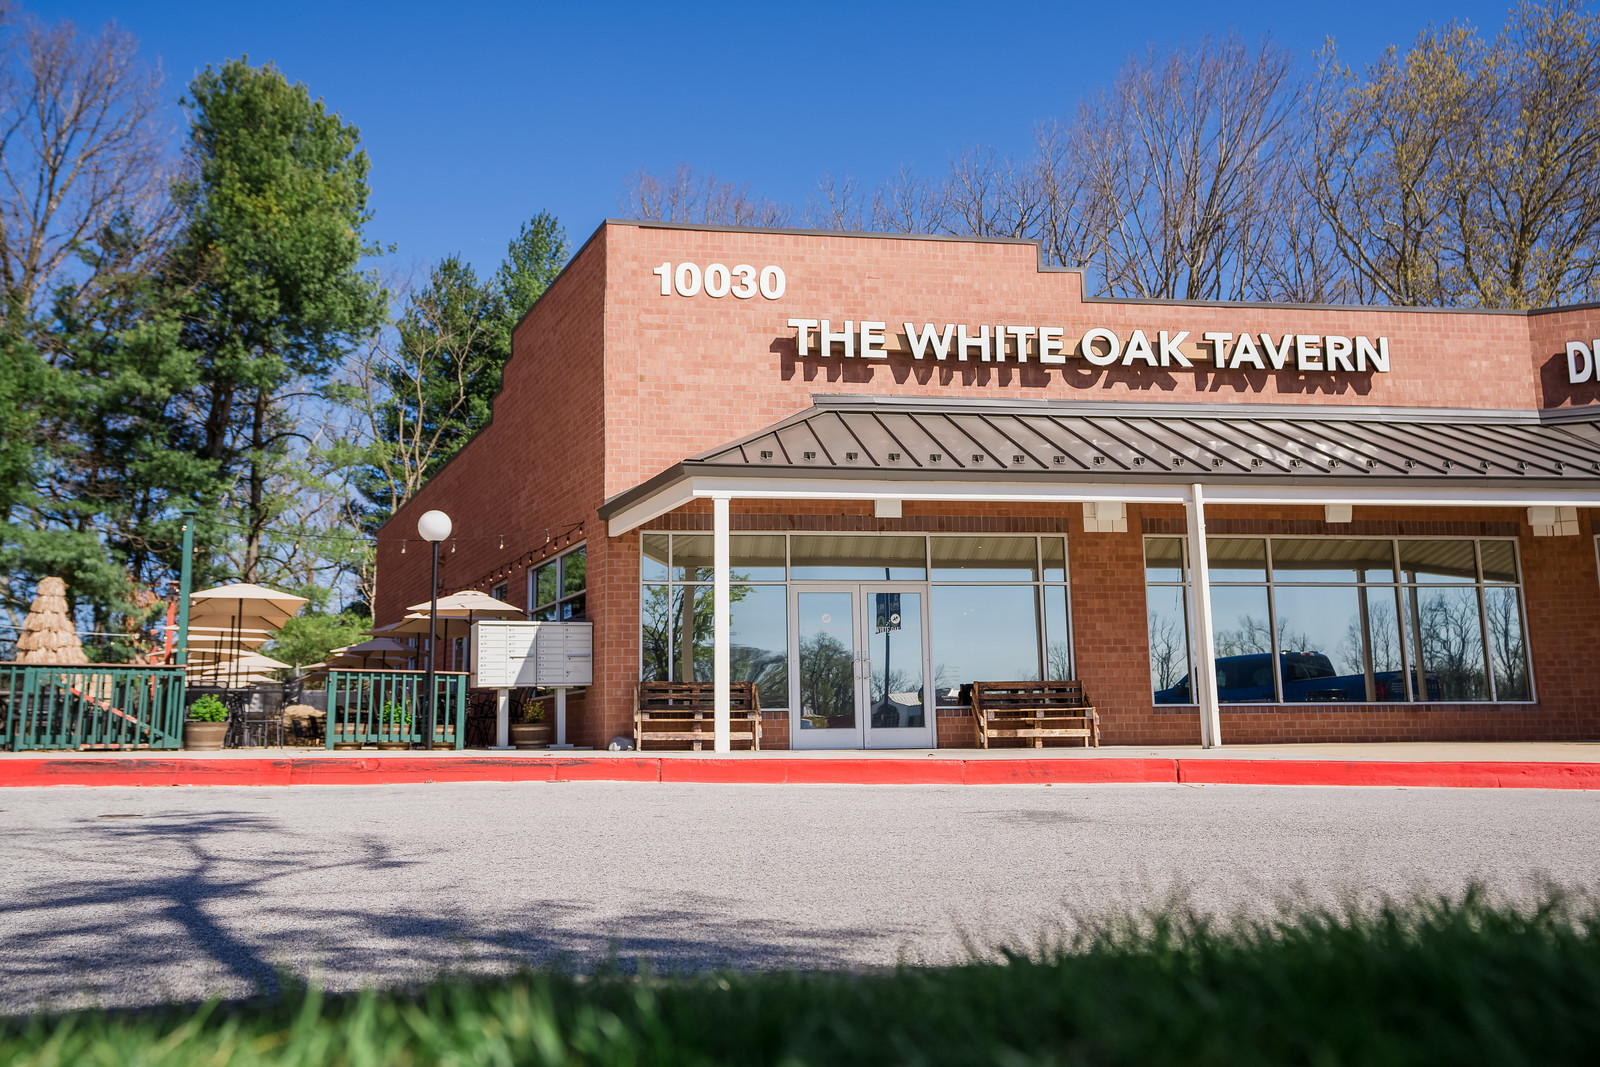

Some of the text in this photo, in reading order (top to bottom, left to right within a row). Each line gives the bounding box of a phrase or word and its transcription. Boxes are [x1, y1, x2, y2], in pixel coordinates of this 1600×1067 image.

[653, 261, 787, 301] 10030
[787, 317, 1392, 374] THE WHITE OAK TAVERN
